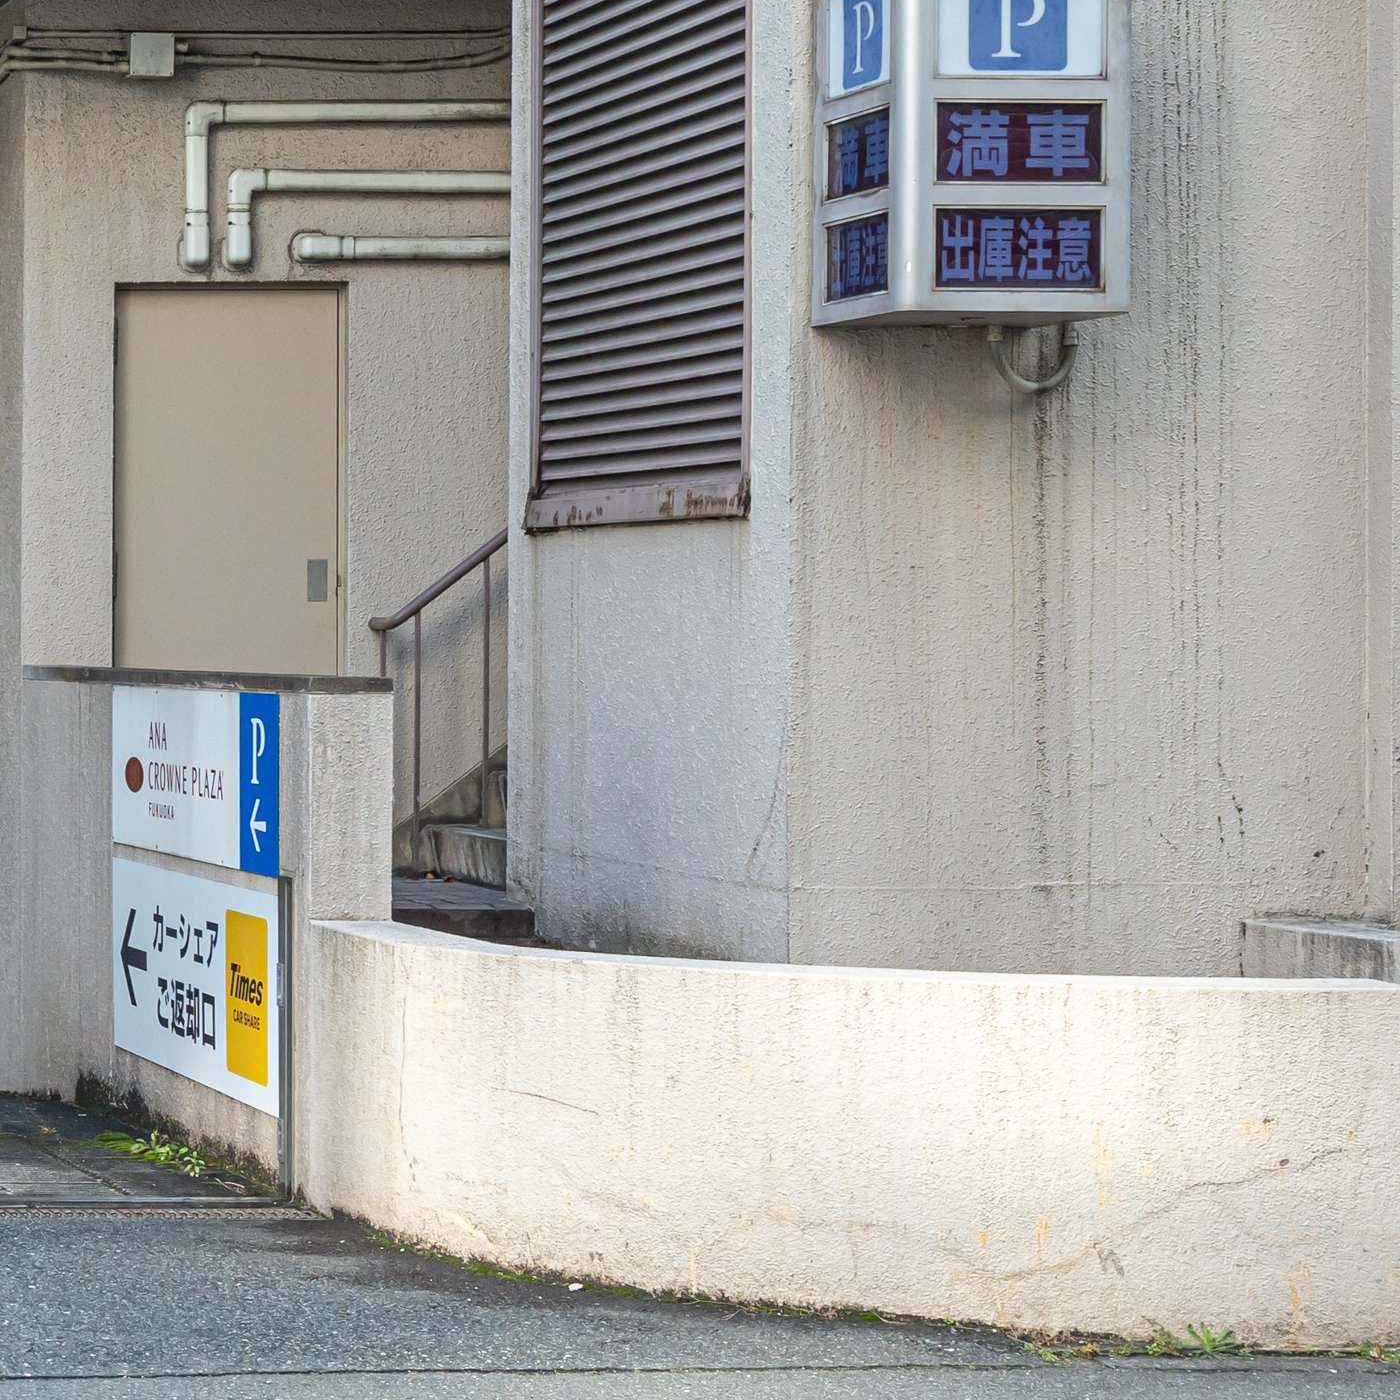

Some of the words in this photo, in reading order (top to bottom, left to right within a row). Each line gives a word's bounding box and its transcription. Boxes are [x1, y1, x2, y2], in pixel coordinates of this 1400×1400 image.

[852, 0, 875, 75] P
[946, 108, 1091, 178] 満車
[940, 215, 1093, 283] 出庫注意
[148, 721, 167, 750] ANA
[250, 717, 266, 784] P
[148, 761, 187, 795] CROWNE
[191, 767, 224, 800] PLAZA
[148, 801, 175, 820] FUKUOKA
[153, 905, 219, 968] カーシェア
[157, 976, 216, 1051] ご返却口
[229, 962, 264, 1007] Times
[232, 1008, 243, 1026] CAR
[243, 1012, 261, 1031] SHARE
